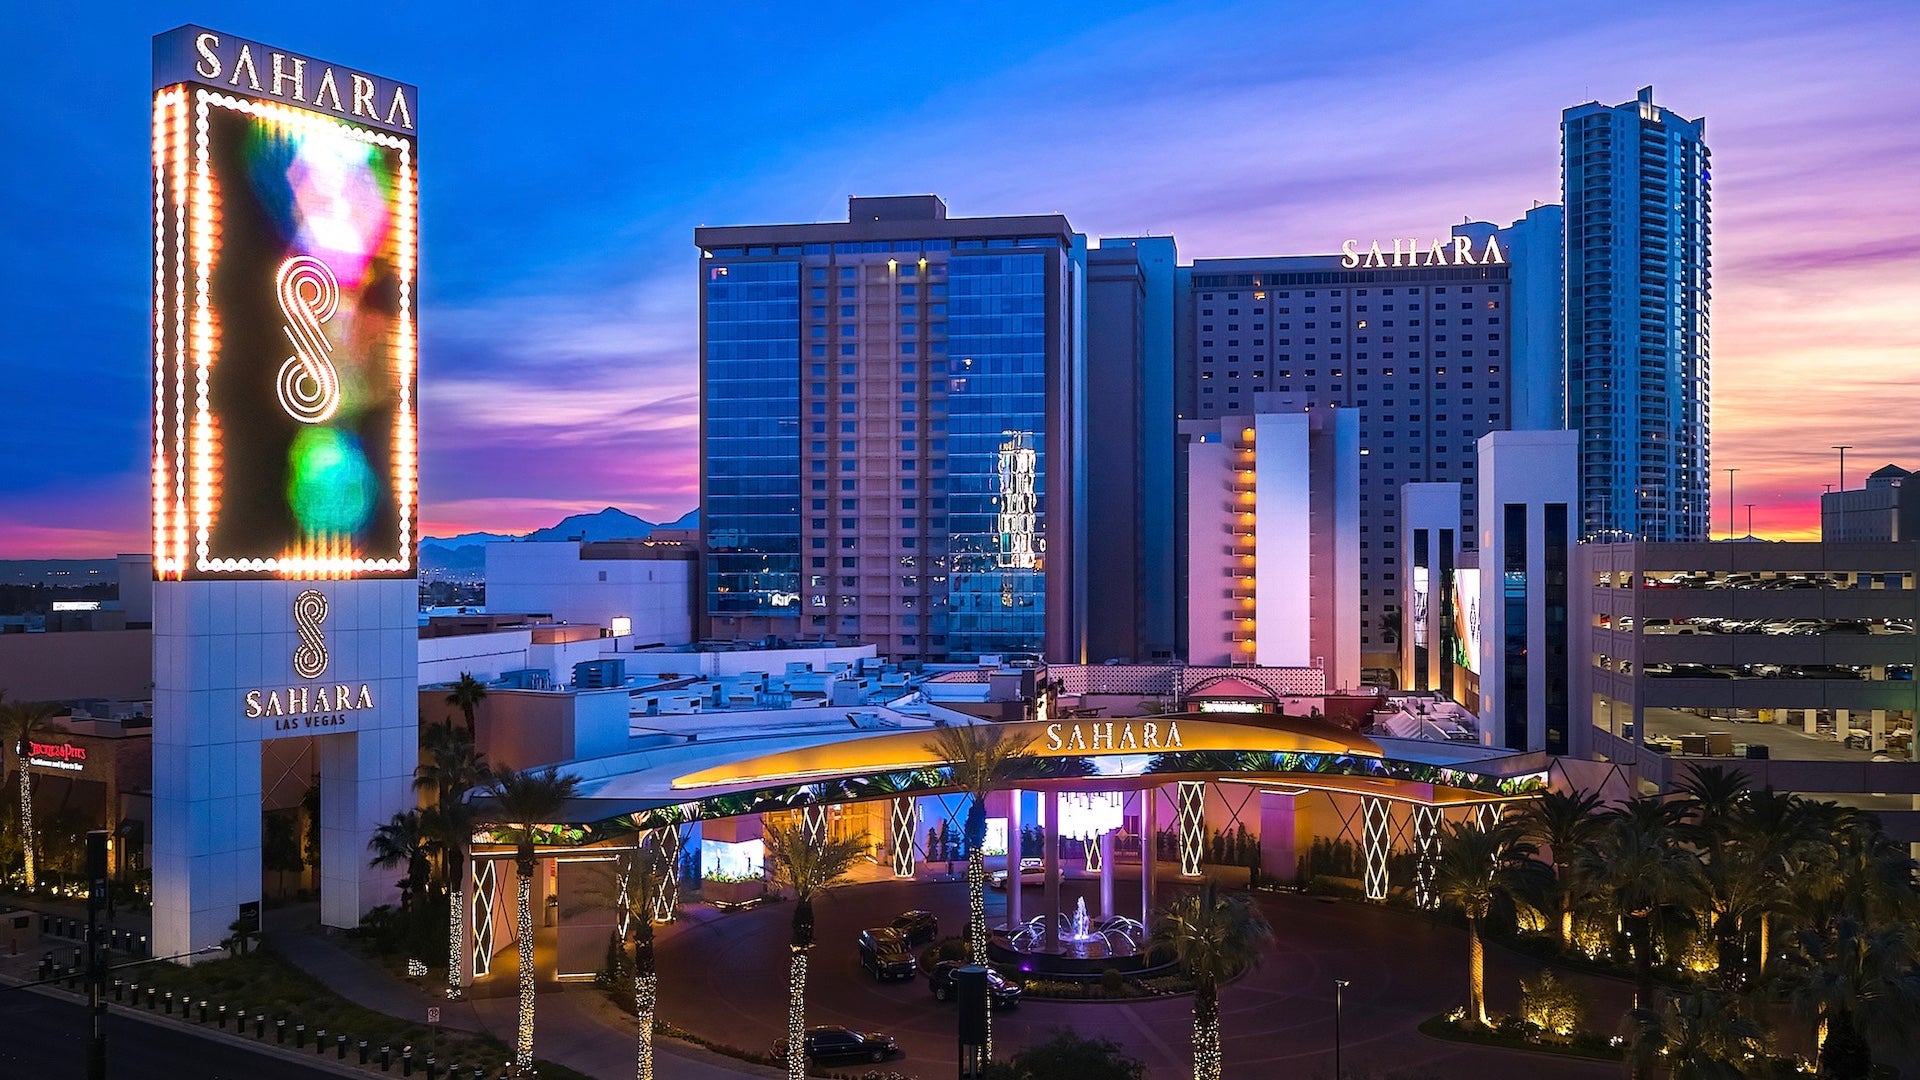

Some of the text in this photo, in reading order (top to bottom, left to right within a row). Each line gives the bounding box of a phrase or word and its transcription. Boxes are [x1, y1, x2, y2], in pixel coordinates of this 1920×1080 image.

[195, 32, 415, 130] SAHARA
[1340, 234, 1506, 269] SAHARA
[245, 683, 375, 719] SAHARA
[275, 713, 346, 731] LAS VEGAS
[1046, 721, 1184, 751] SAHARA
